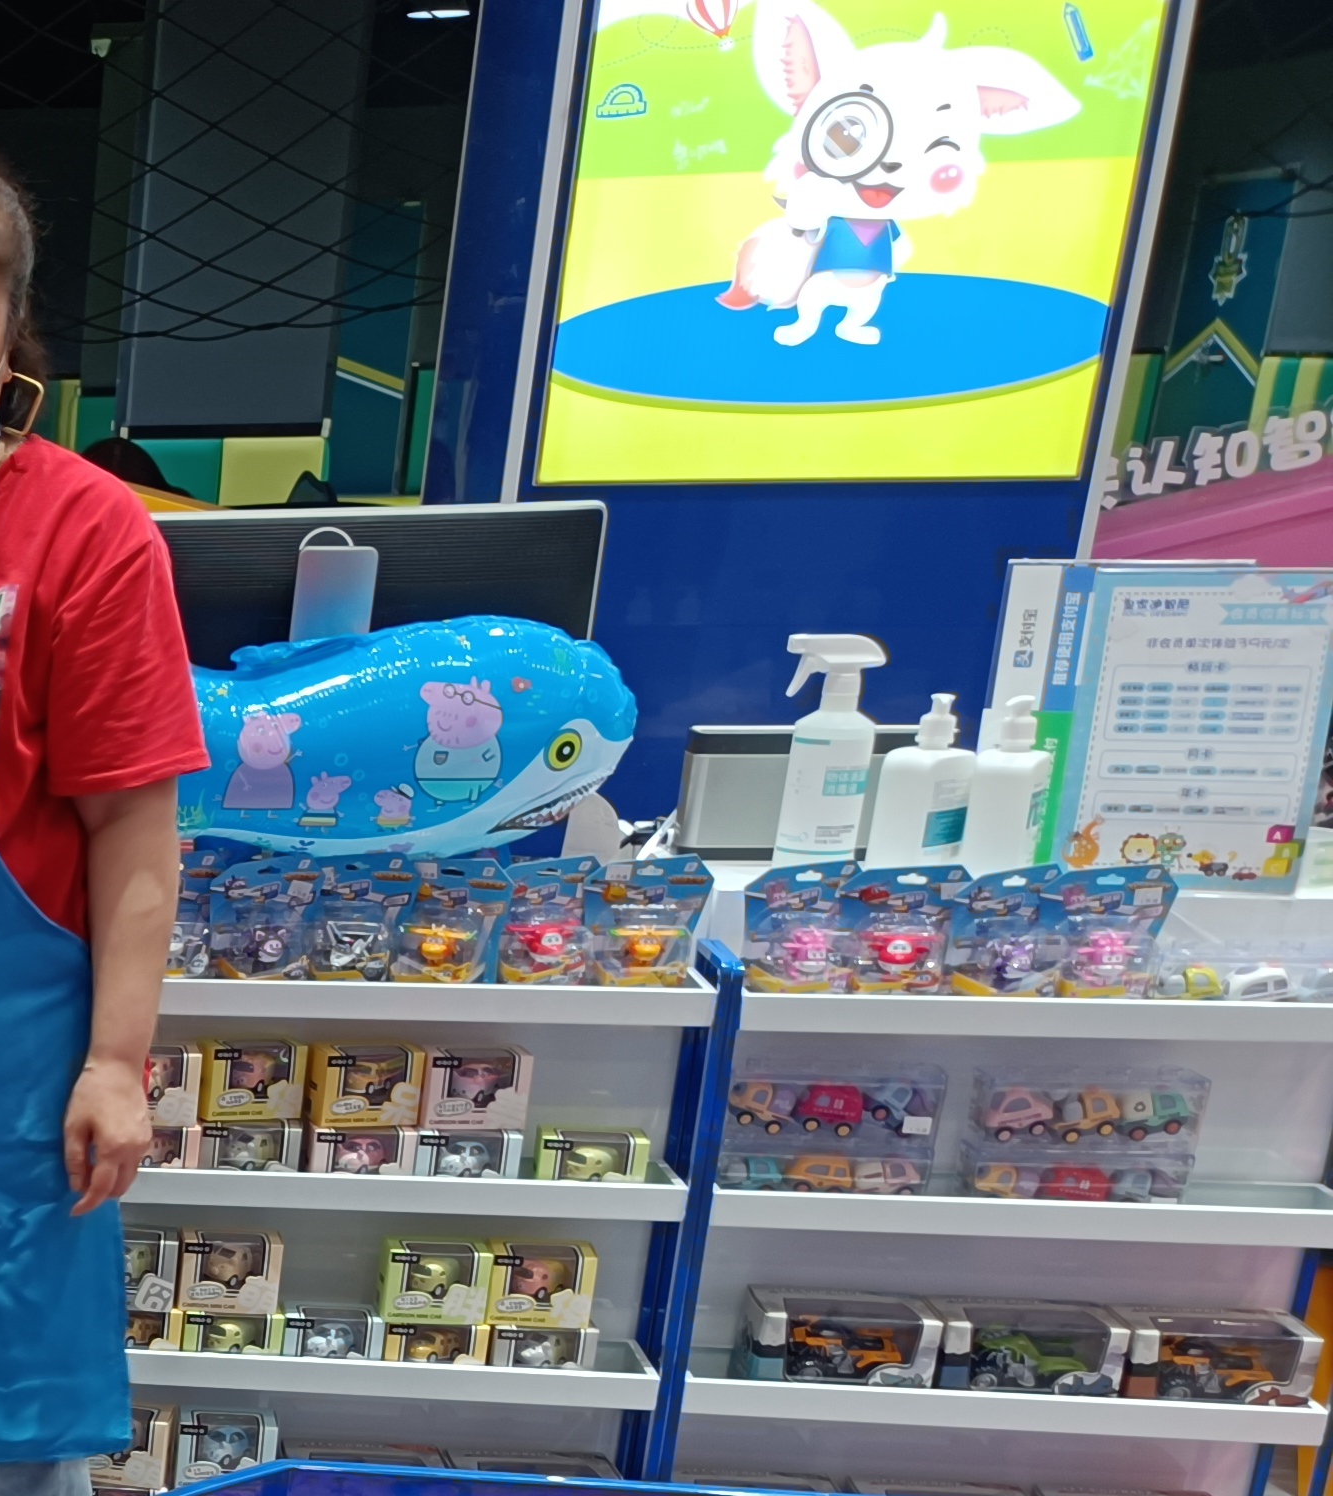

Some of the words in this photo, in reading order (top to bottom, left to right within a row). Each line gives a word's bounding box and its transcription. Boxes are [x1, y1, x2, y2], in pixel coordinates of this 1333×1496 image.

[1100, 410, 1333, 510] 认知智
[1020, 609, 1037, 649] 支付宝
